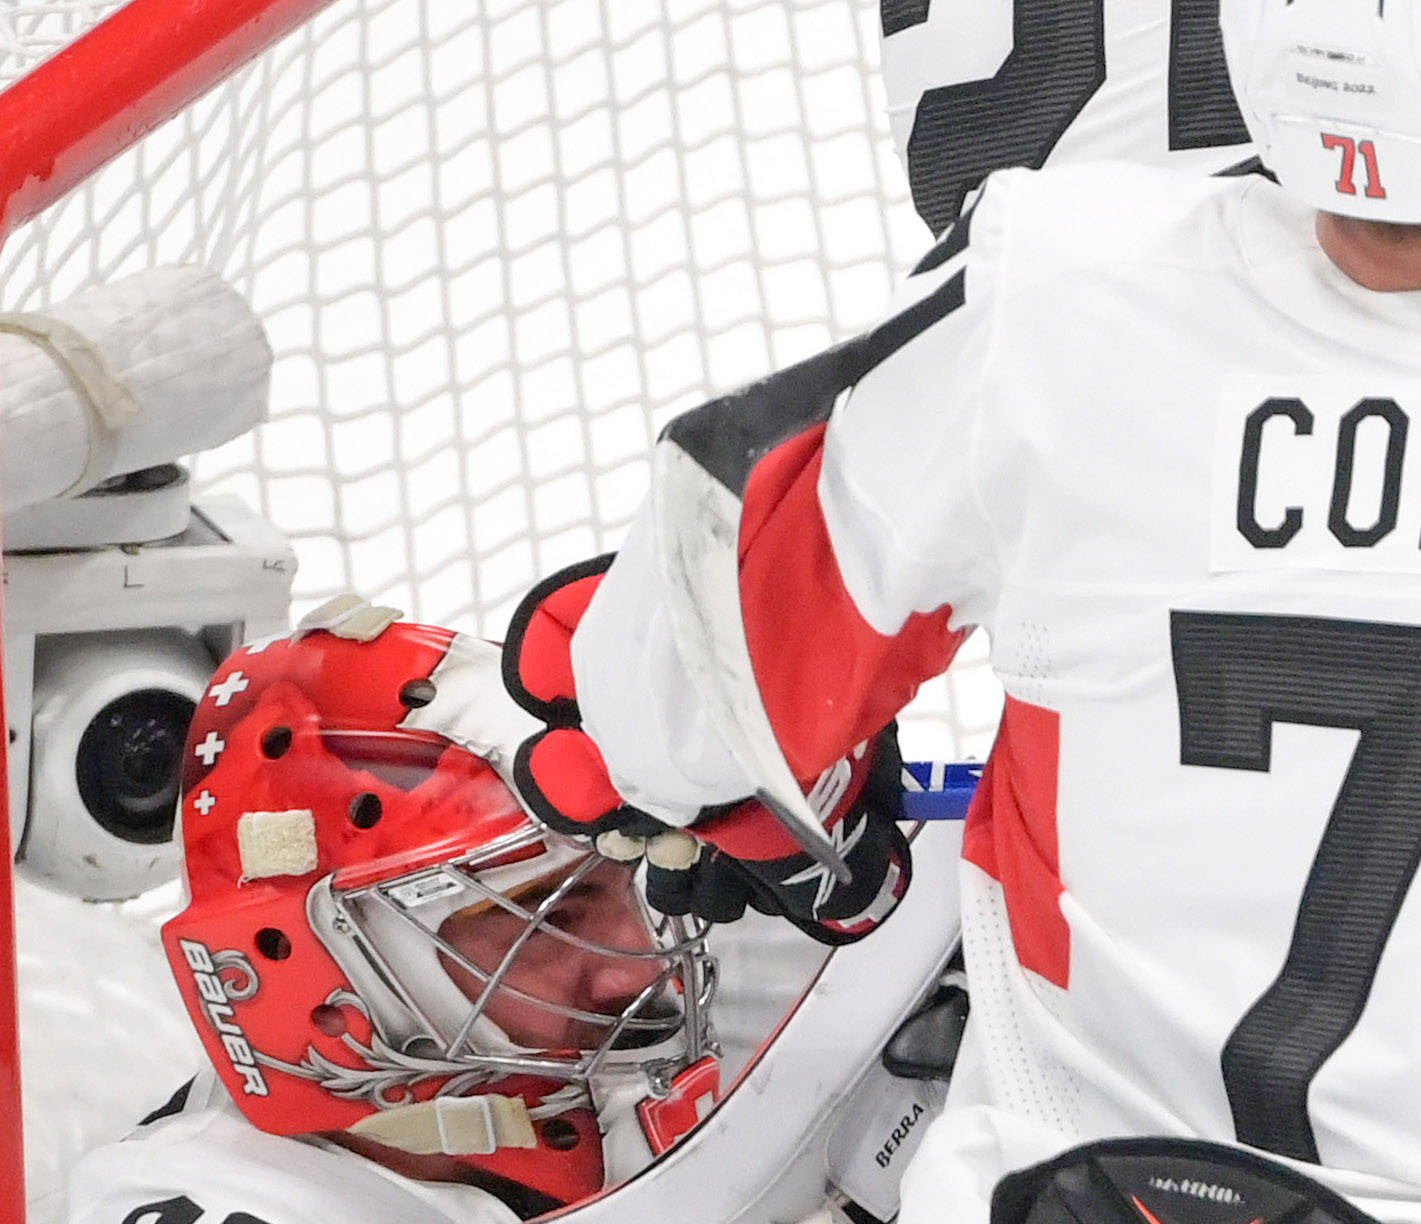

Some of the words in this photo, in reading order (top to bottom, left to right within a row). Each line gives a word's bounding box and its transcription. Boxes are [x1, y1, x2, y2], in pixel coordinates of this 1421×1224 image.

[1321, 132, 1387, 199] 71
[178, 939, 268, 1098] BAUER
[875, 1103, 924, 1168] BERRA
